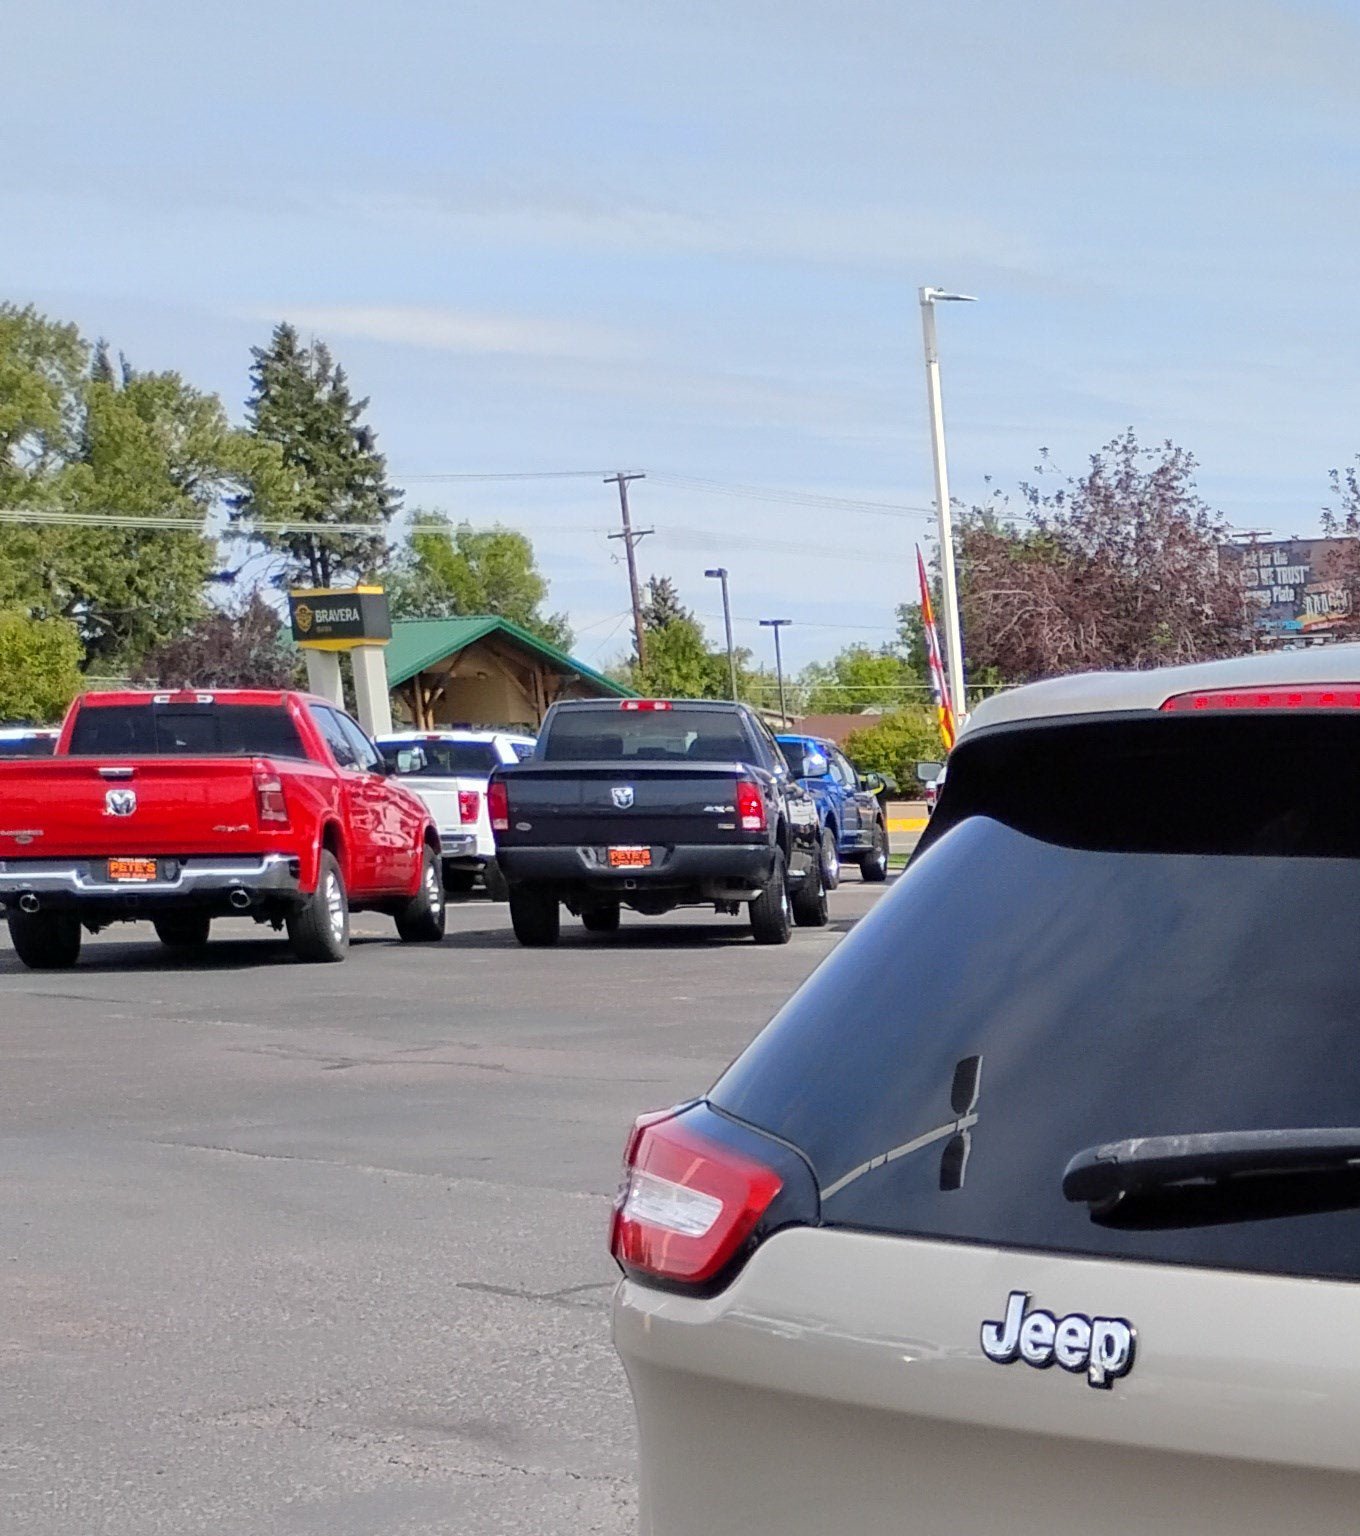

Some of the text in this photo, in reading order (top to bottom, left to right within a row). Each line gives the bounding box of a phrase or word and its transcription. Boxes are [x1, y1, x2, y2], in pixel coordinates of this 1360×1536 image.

[1272, 585, 1296, 602] Plate
[314, 608, 360, 623] BRAVERA
[110, 861, 156, 872] PETE'S
[980, 1289, 1137, 1391] Jeep
